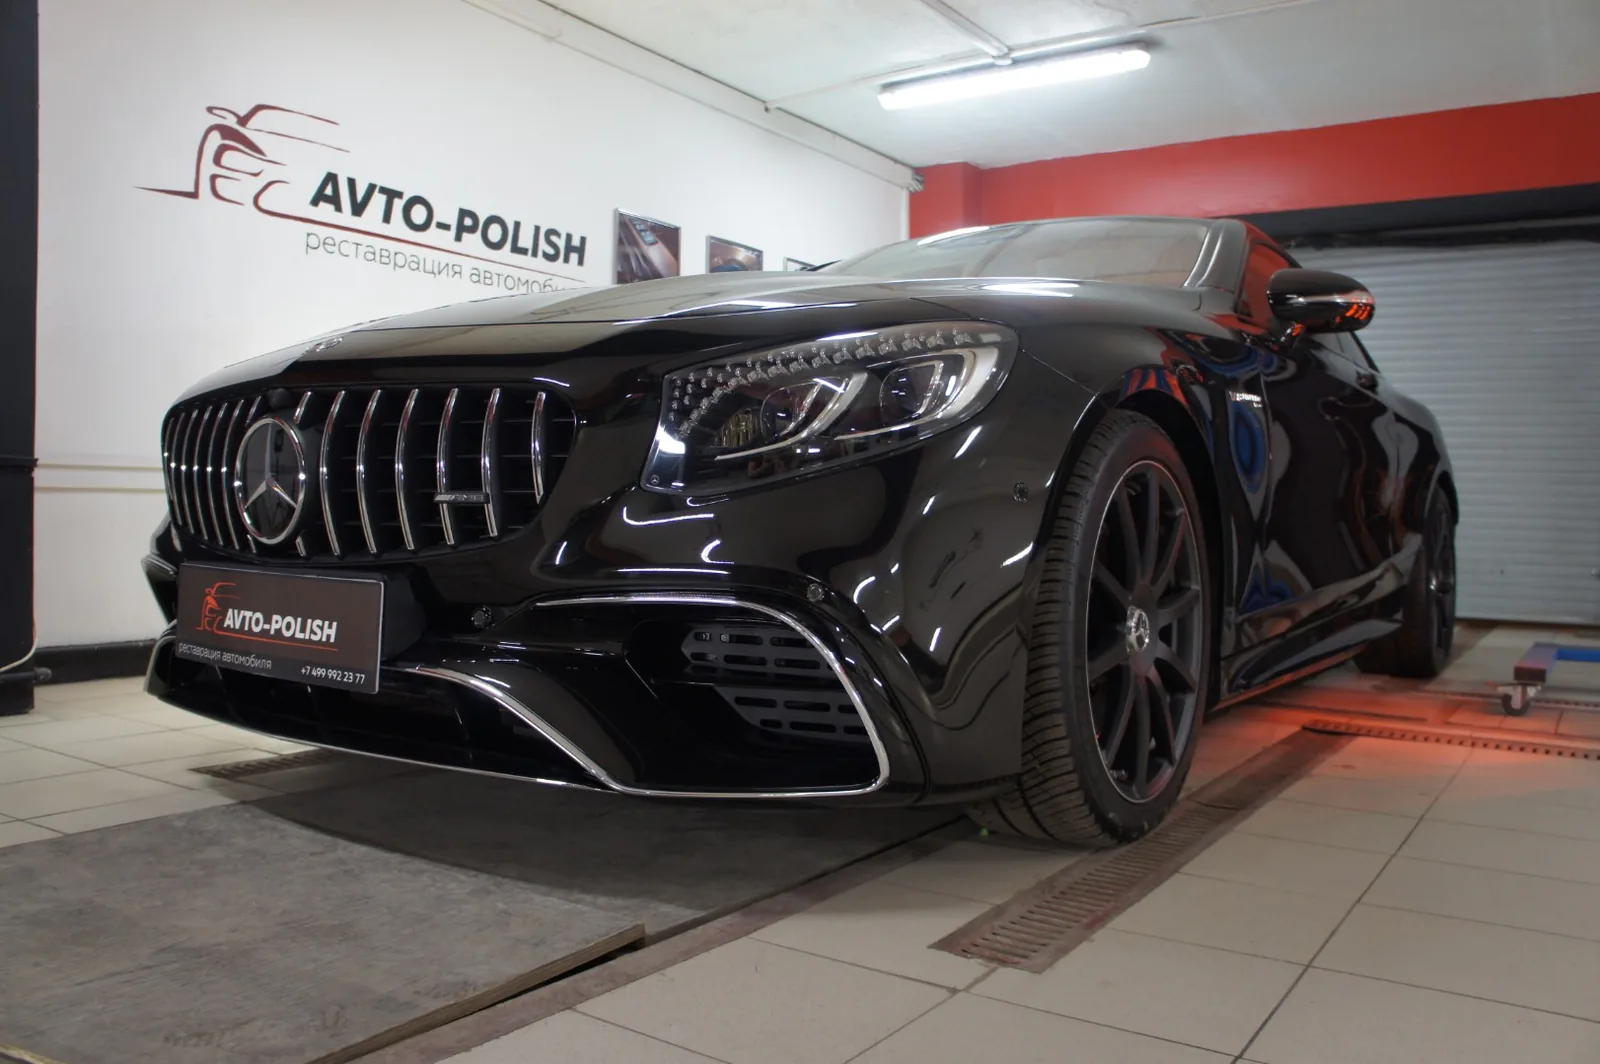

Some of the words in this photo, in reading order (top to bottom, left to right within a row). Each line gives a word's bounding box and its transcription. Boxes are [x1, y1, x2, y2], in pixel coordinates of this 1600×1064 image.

[309, 171, 587, 267] AVTO-POLISH
[305, 231, 463, 280] реставрация
[469, 267, 564, 293] автомоб
[223, 608, 337, 643] AVTO-POLISH
[179, 643, 220, 660] реставрация
[222, 652, 272, 669] автомобиля
[301, 666, 311, 676] +7
[312, 667, 326, 678] 499
[327, 669, 342, 681] 992
[343, 671, 354, 683] 23
[355, 673, 365, 684] 77
